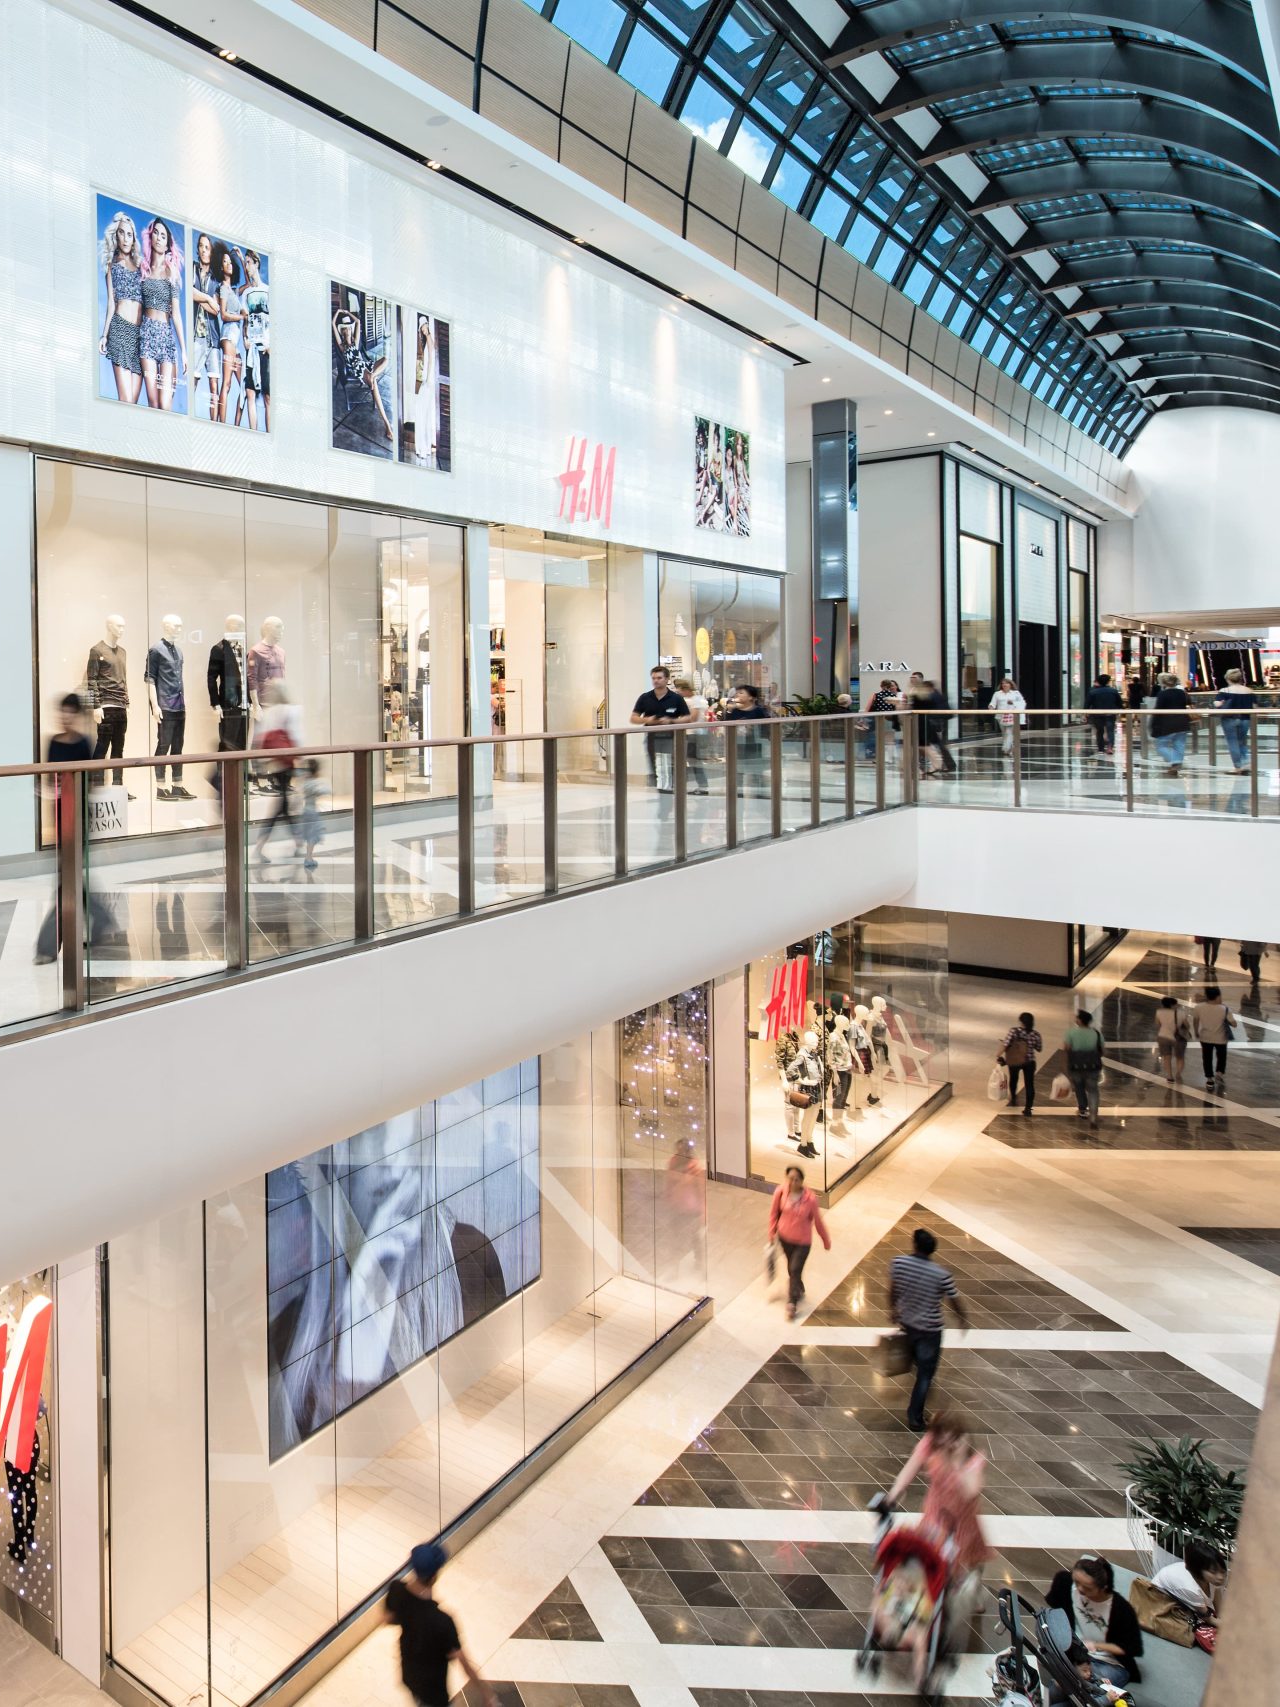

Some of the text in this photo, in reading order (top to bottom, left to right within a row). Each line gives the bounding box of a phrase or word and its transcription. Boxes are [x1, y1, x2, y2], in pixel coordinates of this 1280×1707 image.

[559, 436, 616, 529] H&M
[1190, 641, 1263, 650] AVID JONES
[859, 661, 911, 671] ARA
[88, 817, 122, 832] EASON
[765, 954, 809, 1043] H&M
